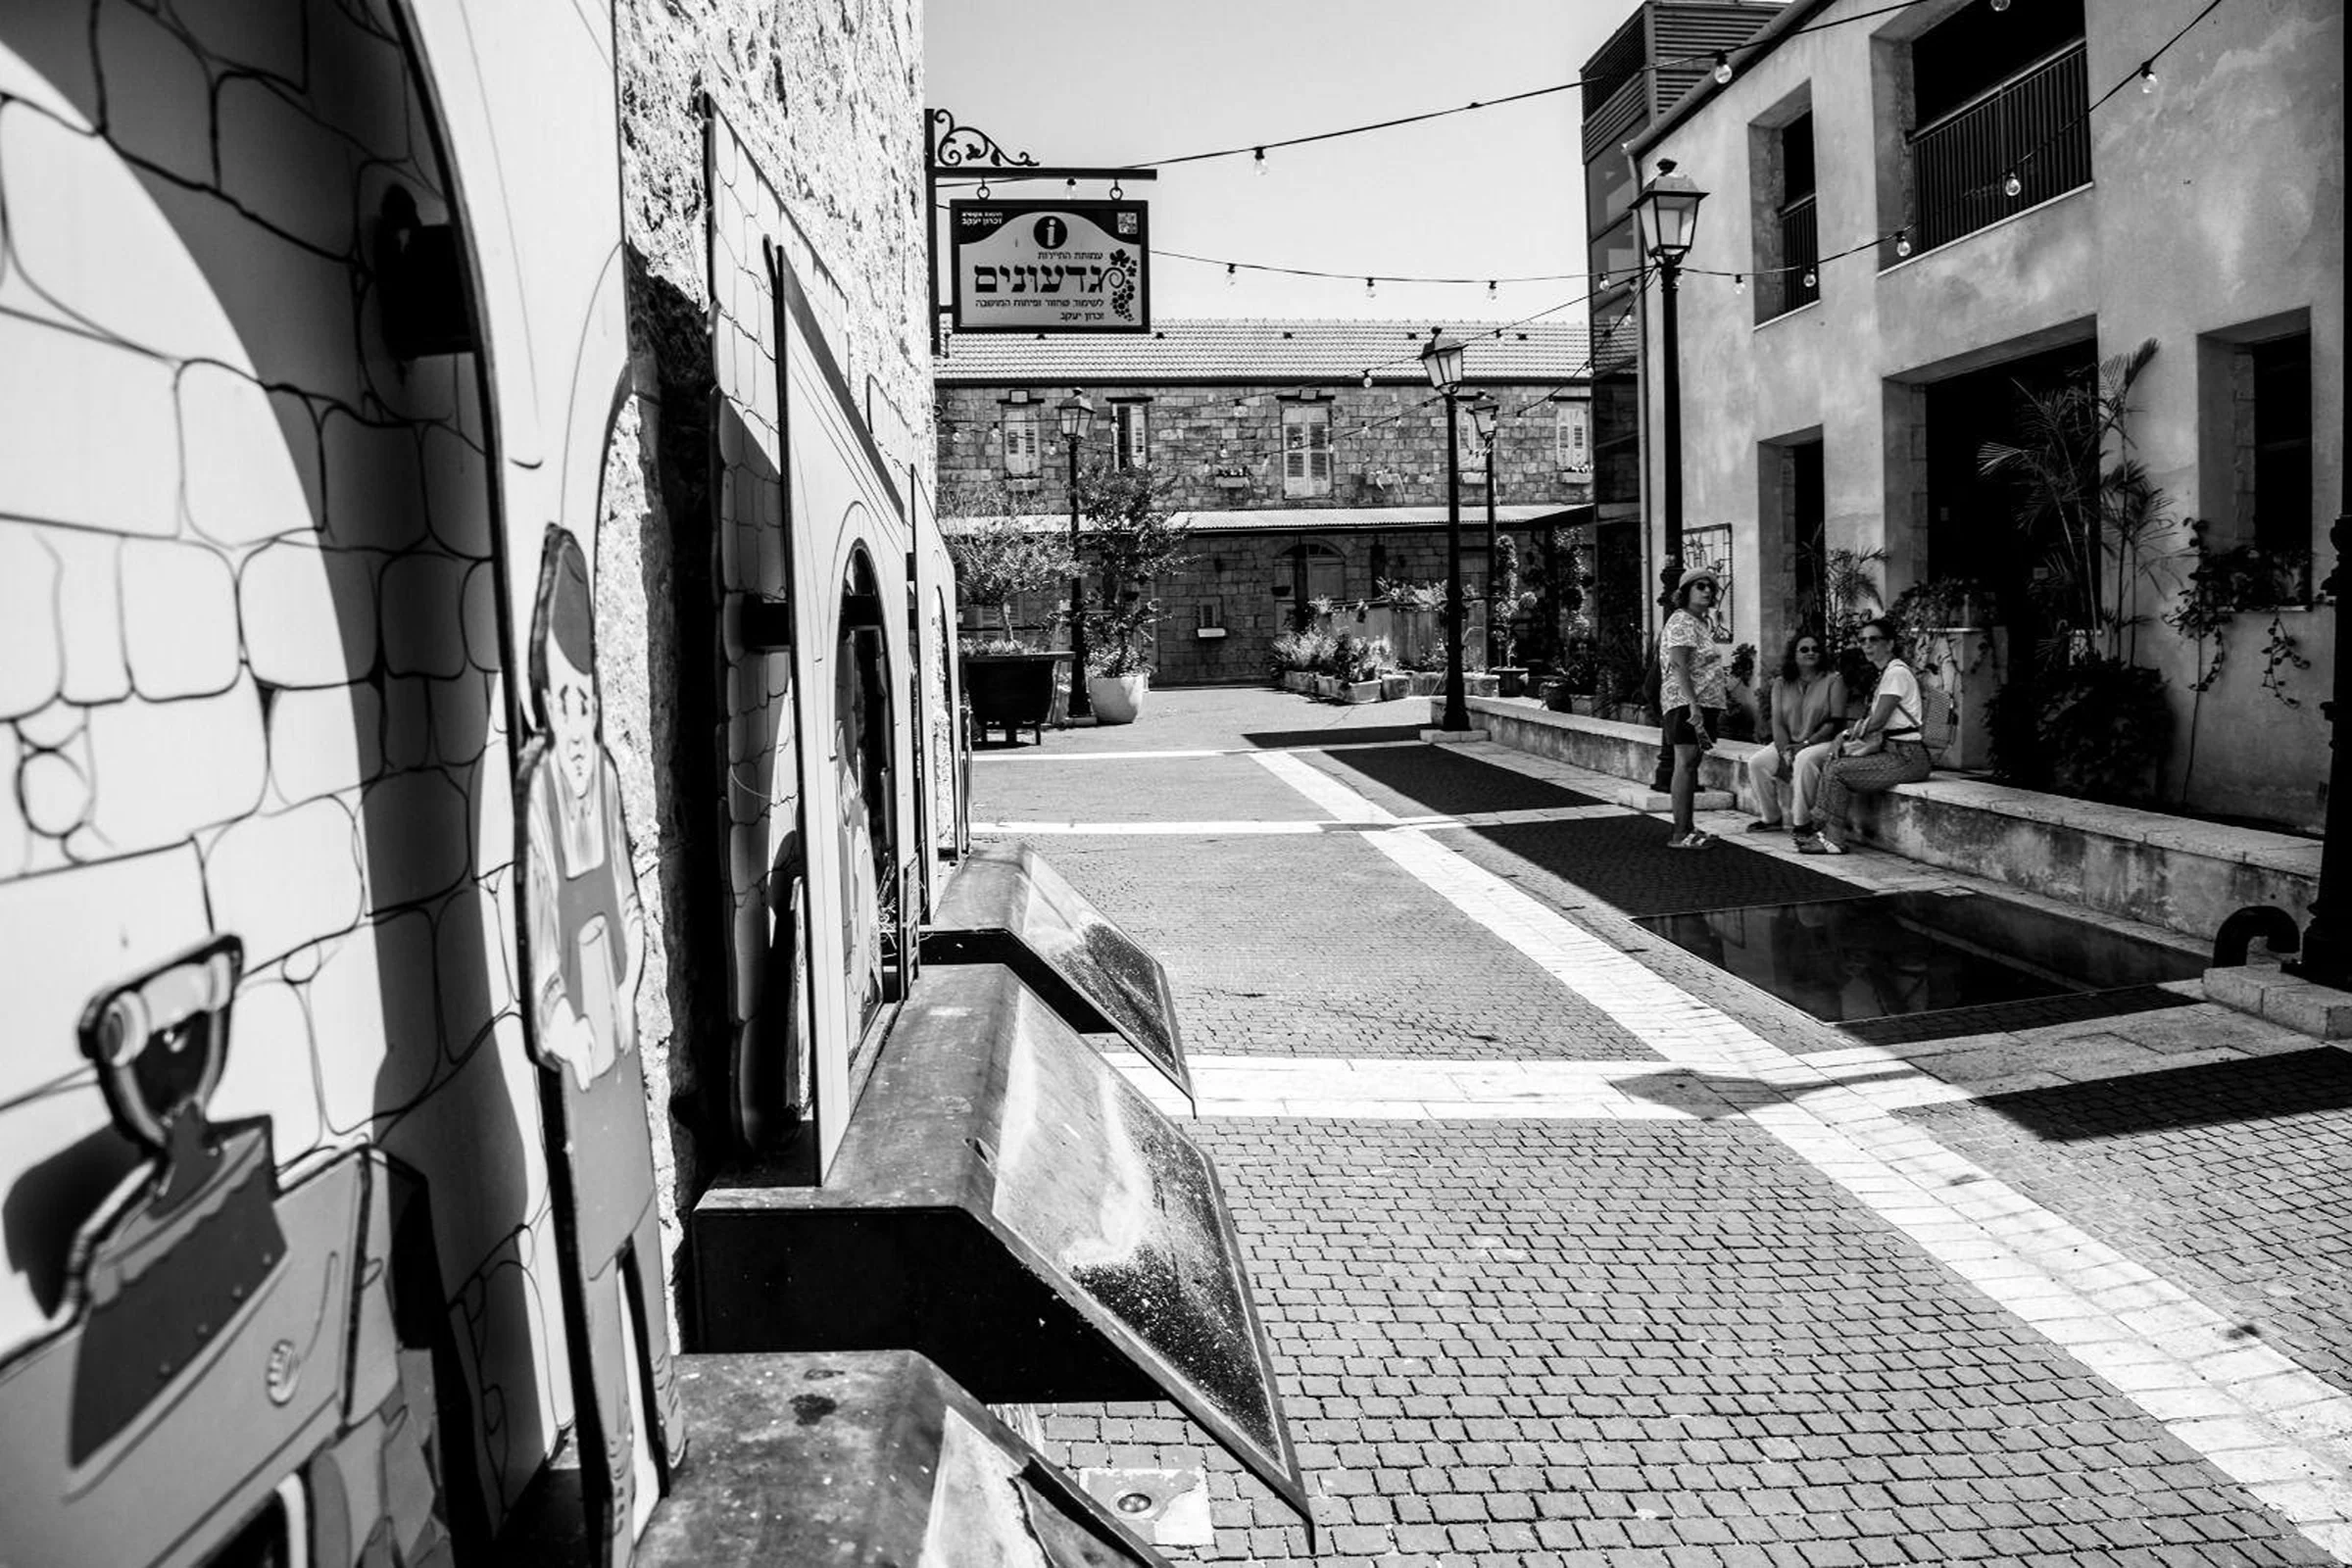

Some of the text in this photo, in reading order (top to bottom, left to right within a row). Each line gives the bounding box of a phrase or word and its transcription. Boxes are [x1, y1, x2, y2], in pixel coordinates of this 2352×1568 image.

[974, 265, 1103, 293] גדעונים
[1059, 312, 1104, 321] זכרון יעקב
